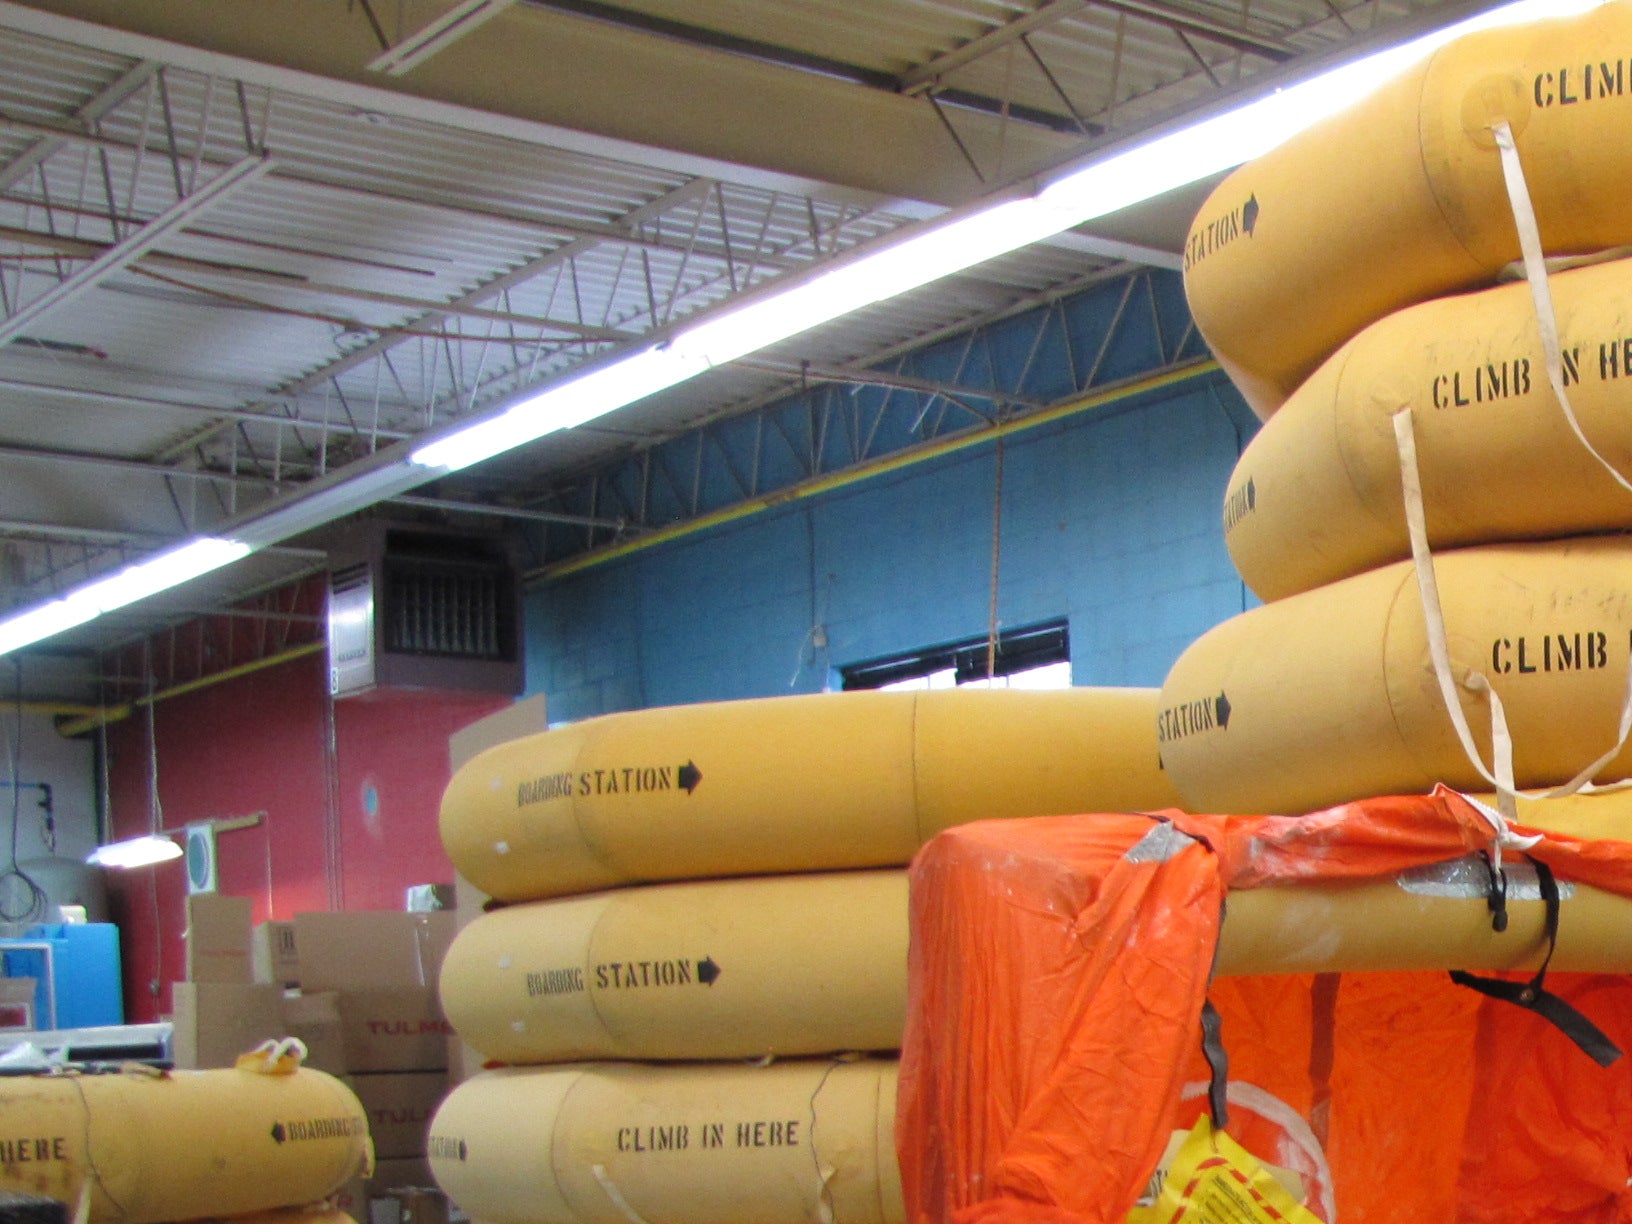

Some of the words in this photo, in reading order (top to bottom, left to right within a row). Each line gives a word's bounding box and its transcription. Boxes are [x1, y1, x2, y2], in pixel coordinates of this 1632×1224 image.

[1185, 207, 1239, 272] STATION
[1433, 358, 1531, 409] CLIMB
[1492, 631, 1607, 674] CLIMB
[1158, 697, 1213, 742] STATION
[580, 766, 672, 796] STATION
[596, 958, 692, 988] STATION
[618, 1125, 690, 1152] CLIMB
[703, 1124, 724, 1148] IN
[737, 1120, 799, 1147] HERE
